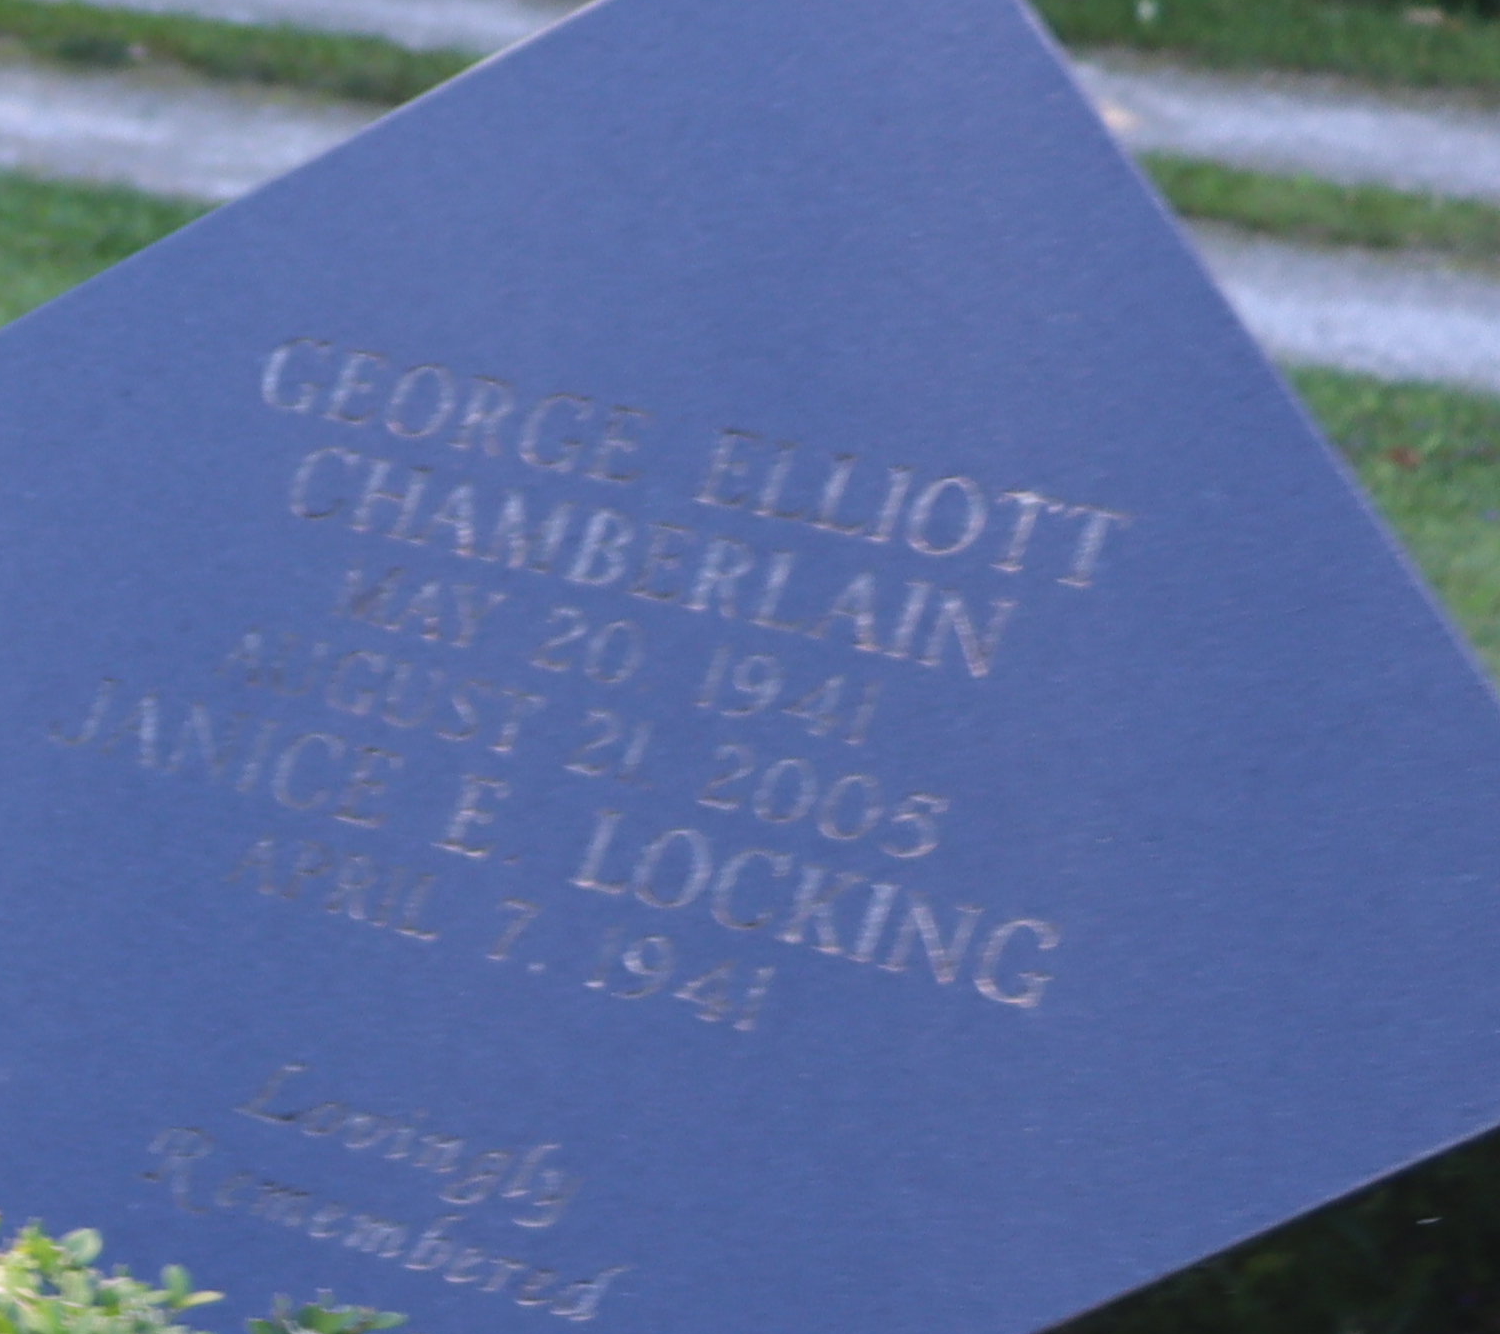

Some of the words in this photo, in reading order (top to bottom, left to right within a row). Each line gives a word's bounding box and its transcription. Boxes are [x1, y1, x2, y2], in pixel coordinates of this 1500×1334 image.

[261, 335, 655, 483] GEORGE
[693, 426, 1132, 589] ELLIOTT
[290, 444, 1020, 679] CHAMBERLAIN
[216, 624, 548, 755] AUGUST
[697, 741, 952, 859] 2005
[330, 565, 508, 649] MAY
[693, 643, 884, 747] 1941
[46, 674, 403, 829] JANICE
[568, 809, 1064, 1011] LOCKING
[222, 831, 442, 943] APRIL
[582, 931, 778, 1033] 1941
[136, 1124, 632, 1323] Remembered
[233, 1062, 588, 1230] Lovingly
